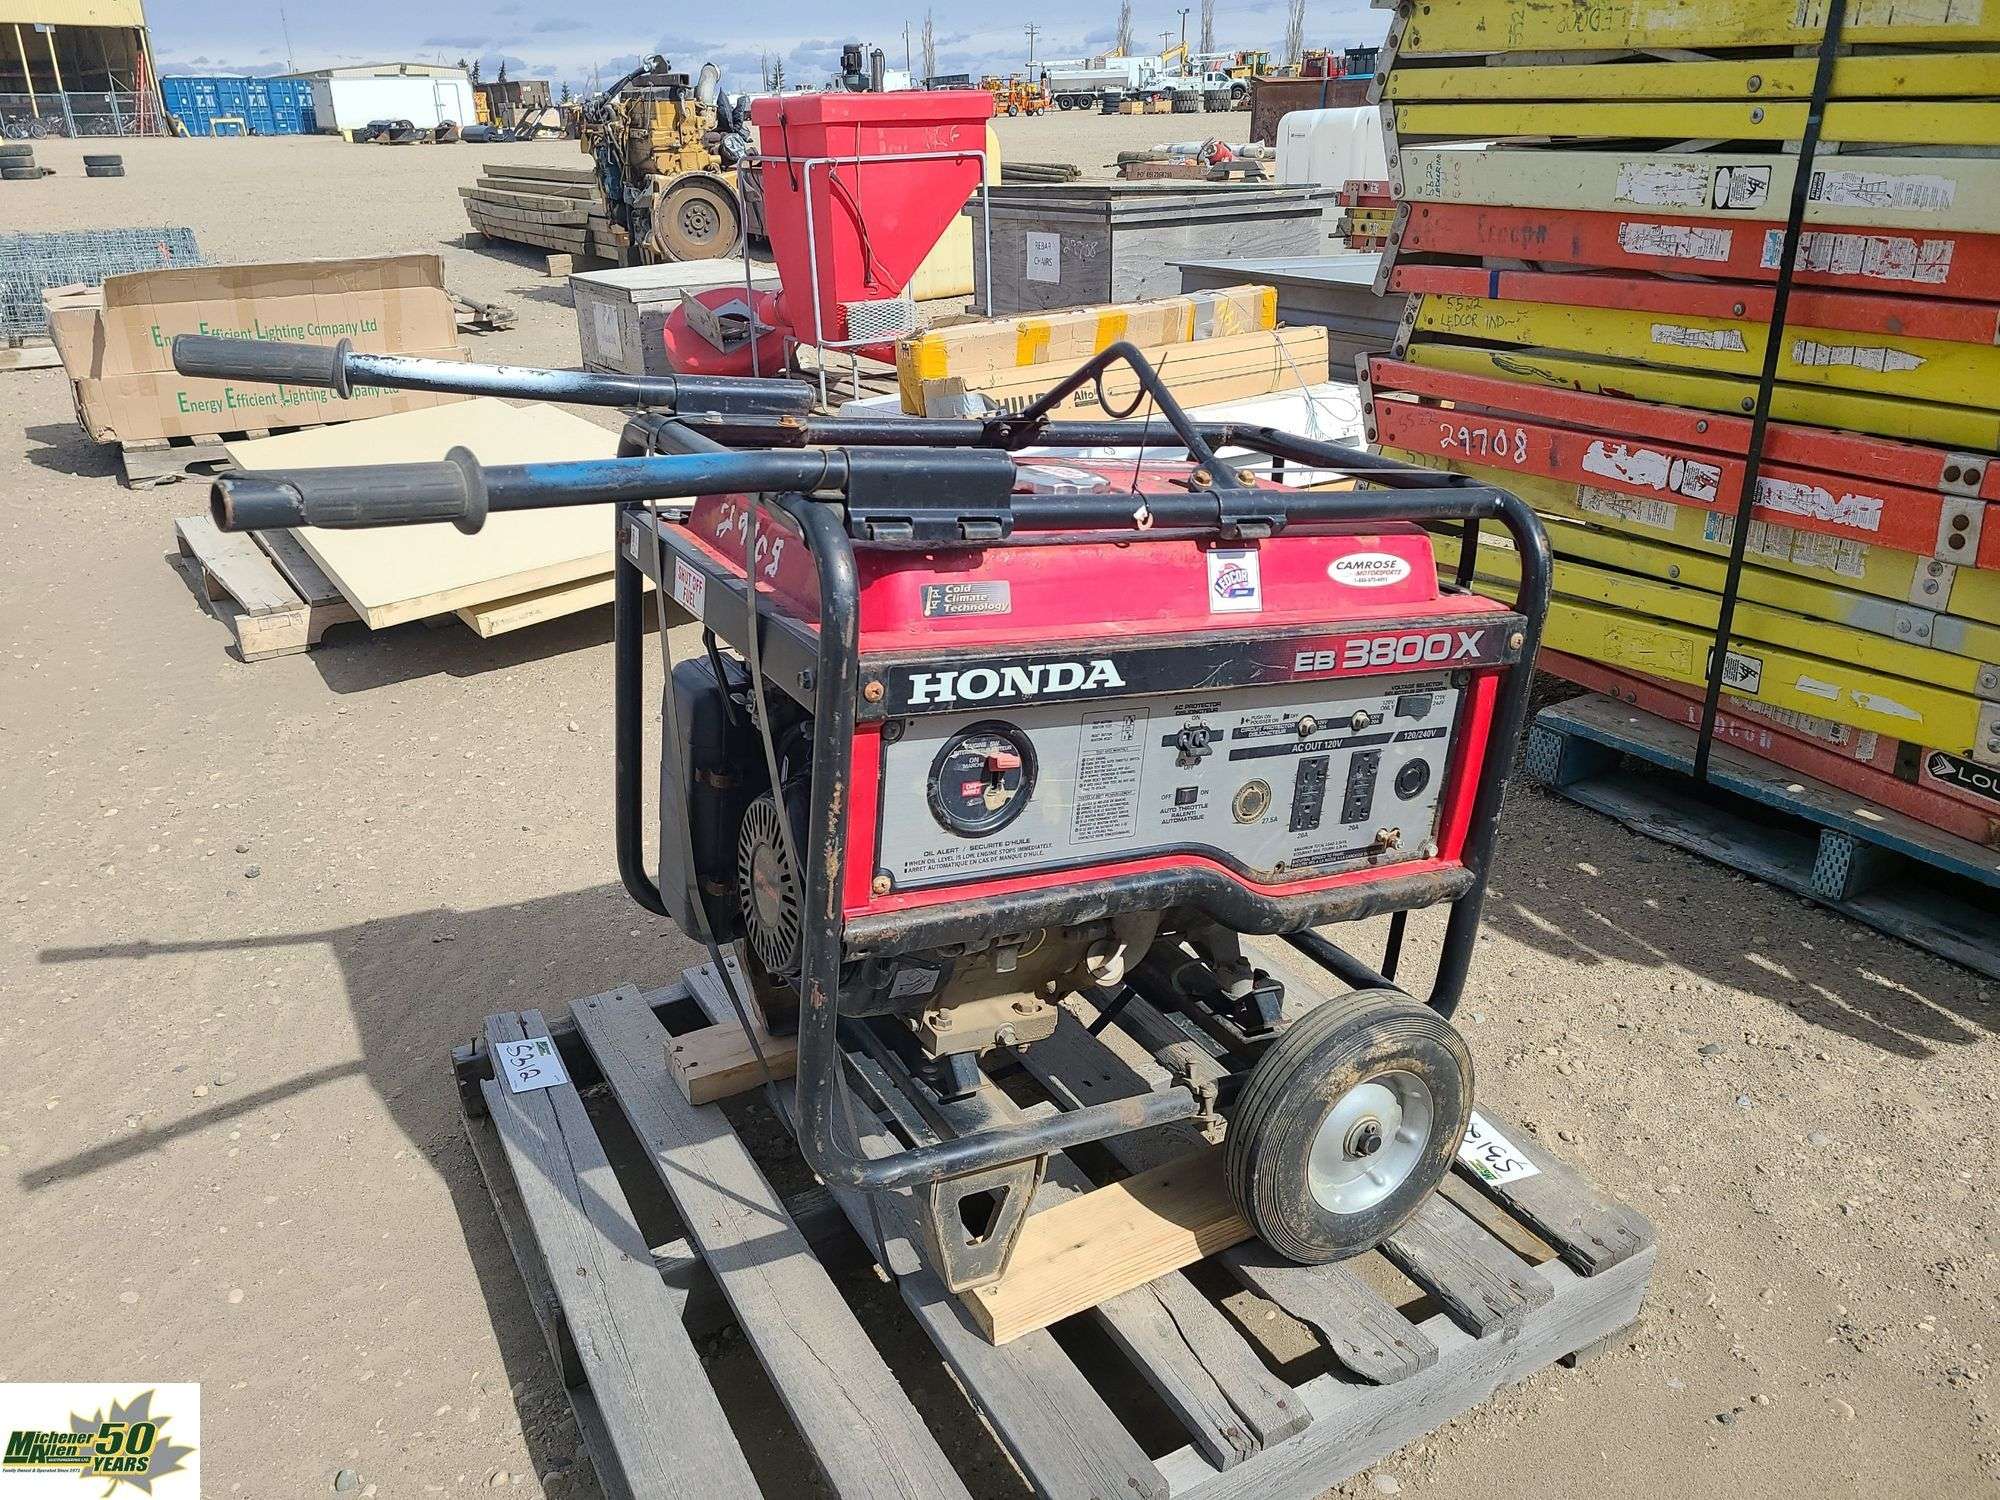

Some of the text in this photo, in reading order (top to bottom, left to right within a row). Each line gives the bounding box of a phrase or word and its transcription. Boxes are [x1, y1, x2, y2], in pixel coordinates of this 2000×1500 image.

[1440, 311, 1479, 327] LEDCOR
[254, 319, 305, 341] Lighting
[307, 321, 358, 340] Company
[360, 318, 377, 333] Ltd
[177, 384, 380, 414] Energy Efficient Lighting Cpany
[1440, 423, 1527, 464] 29708
[1336, 560, 1397, 570] CAMROSE
[1355, 569, 1402, 577] MOTORSPORTS
[678, 565, 703, 594] SHUT OFF
[945, 584, 971, 593] Cold
[683, 587, 696, 608] FUEL
[944, 593, 987, 603] Climate
[943, 601, 1008, 614] Technology
[1294, 650, 1336, 672] EB
[907, 659, 1126, 704] HONDA
[1184, 701, 1222, 709] PROTECTOR
[1264, 723, 1296, 731] PROTECTOR
[1403, 729, 1437, 740] 120/240V
[1291, 740, 1343, 752] AC OUT 120V
[1178, 803, 1208, 812] THROTTLE
[1161, 814, 1205, 825] AUTOMATIQUE
[1171, 810, 1196, 818] RALENTI
[908, 859, 926, 867] WHEN
[937, 855, 955, 863] LEVEL
[977, 849, 998, 858] ENGINE
[998, 847, 1016, 855] STOPS
[936, 847, 959, 856] ALERT
[908, 866, 927, 874] ARRET
[927, 861, 968, 871] AUTOMATIQUE
[999, 853, 1023, 862] MANQUE
